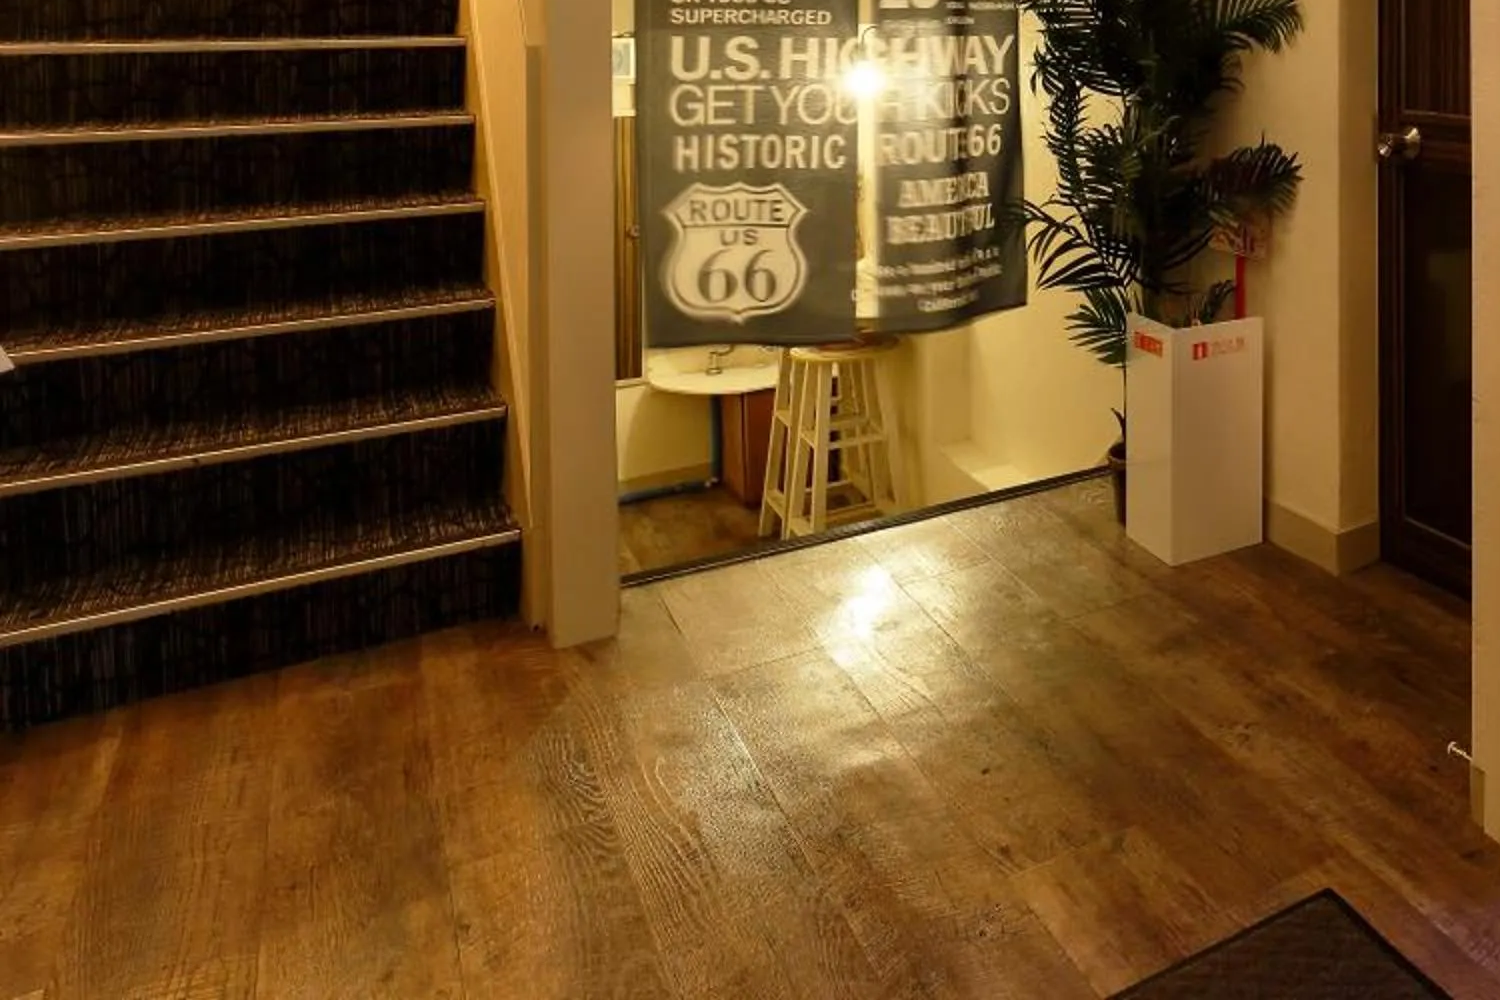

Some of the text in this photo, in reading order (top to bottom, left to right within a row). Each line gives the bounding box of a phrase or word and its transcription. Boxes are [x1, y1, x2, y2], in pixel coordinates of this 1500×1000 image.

[671, 8, 832, 25] SUPERCHARGED
[671, 35, 770, 81] U.S.
[670, 83, 765, 126] GET
[673, 133, 848, 172] HISTORIC
[966, 123, 1003, 158] 66
[689, 199, 784, 223] ROUTE
[720, 228, 758, 246] US
[697, 247, 777, 303] 66
